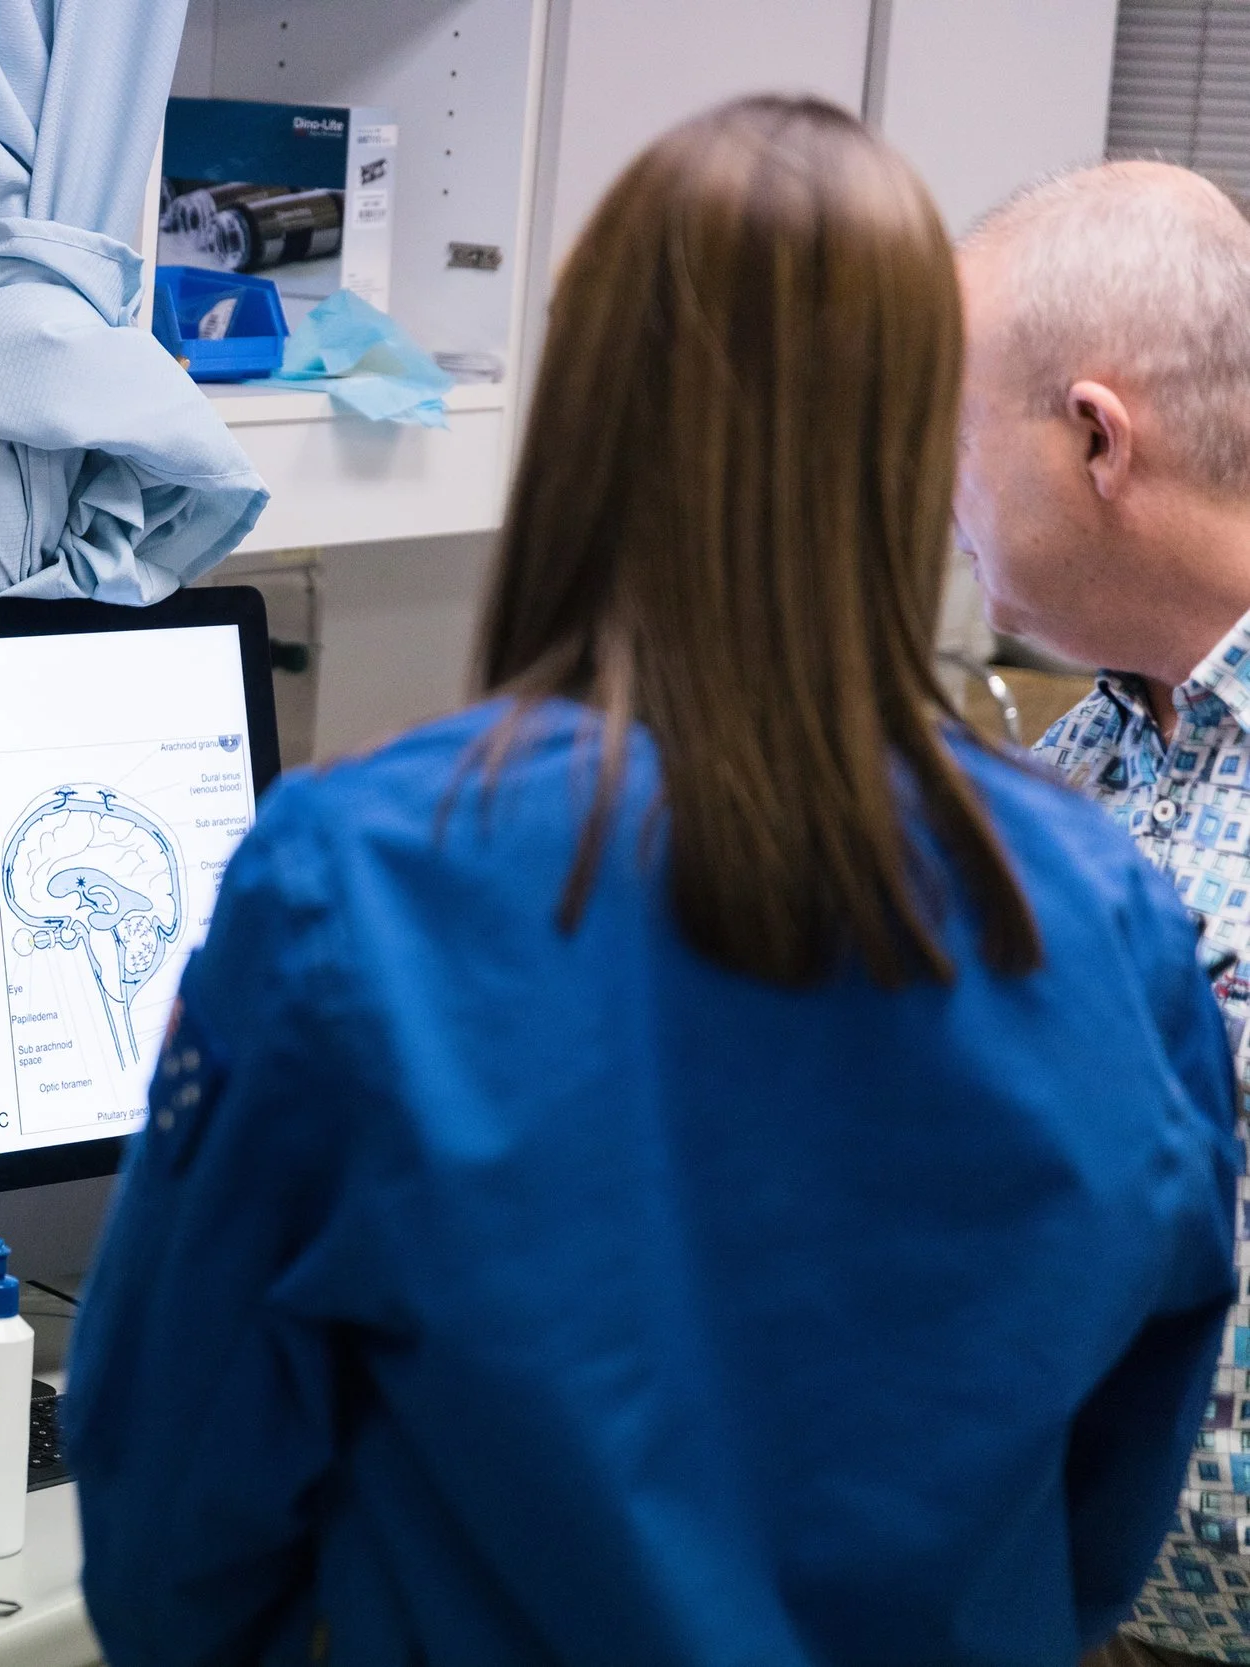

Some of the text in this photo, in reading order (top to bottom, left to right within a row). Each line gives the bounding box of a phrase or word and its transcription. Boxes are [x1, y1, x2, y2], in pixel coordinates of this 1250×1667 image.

[293, 116, 344, 131] Dino-Lite
[161, 738, 239, 751] Arachnoid granuation
[202, 772, 241, 782] Dural sinus
[190, 783, 242, 796] (venous blood)
[196, 816, 247, 828] Sub arachnoid
[226, 828, 248, 838] space
[8, 985, 23, 995] Eye
[12, 1011, 58, 1025] Papilledema
[18, 1040, 73, 1055] Sub arachnoid
[19, 1056, 42, 1067] space
[40, 1078, 93, 1093] Optic foramen
[97, 1106, 149, 1121] Pituitary gland
